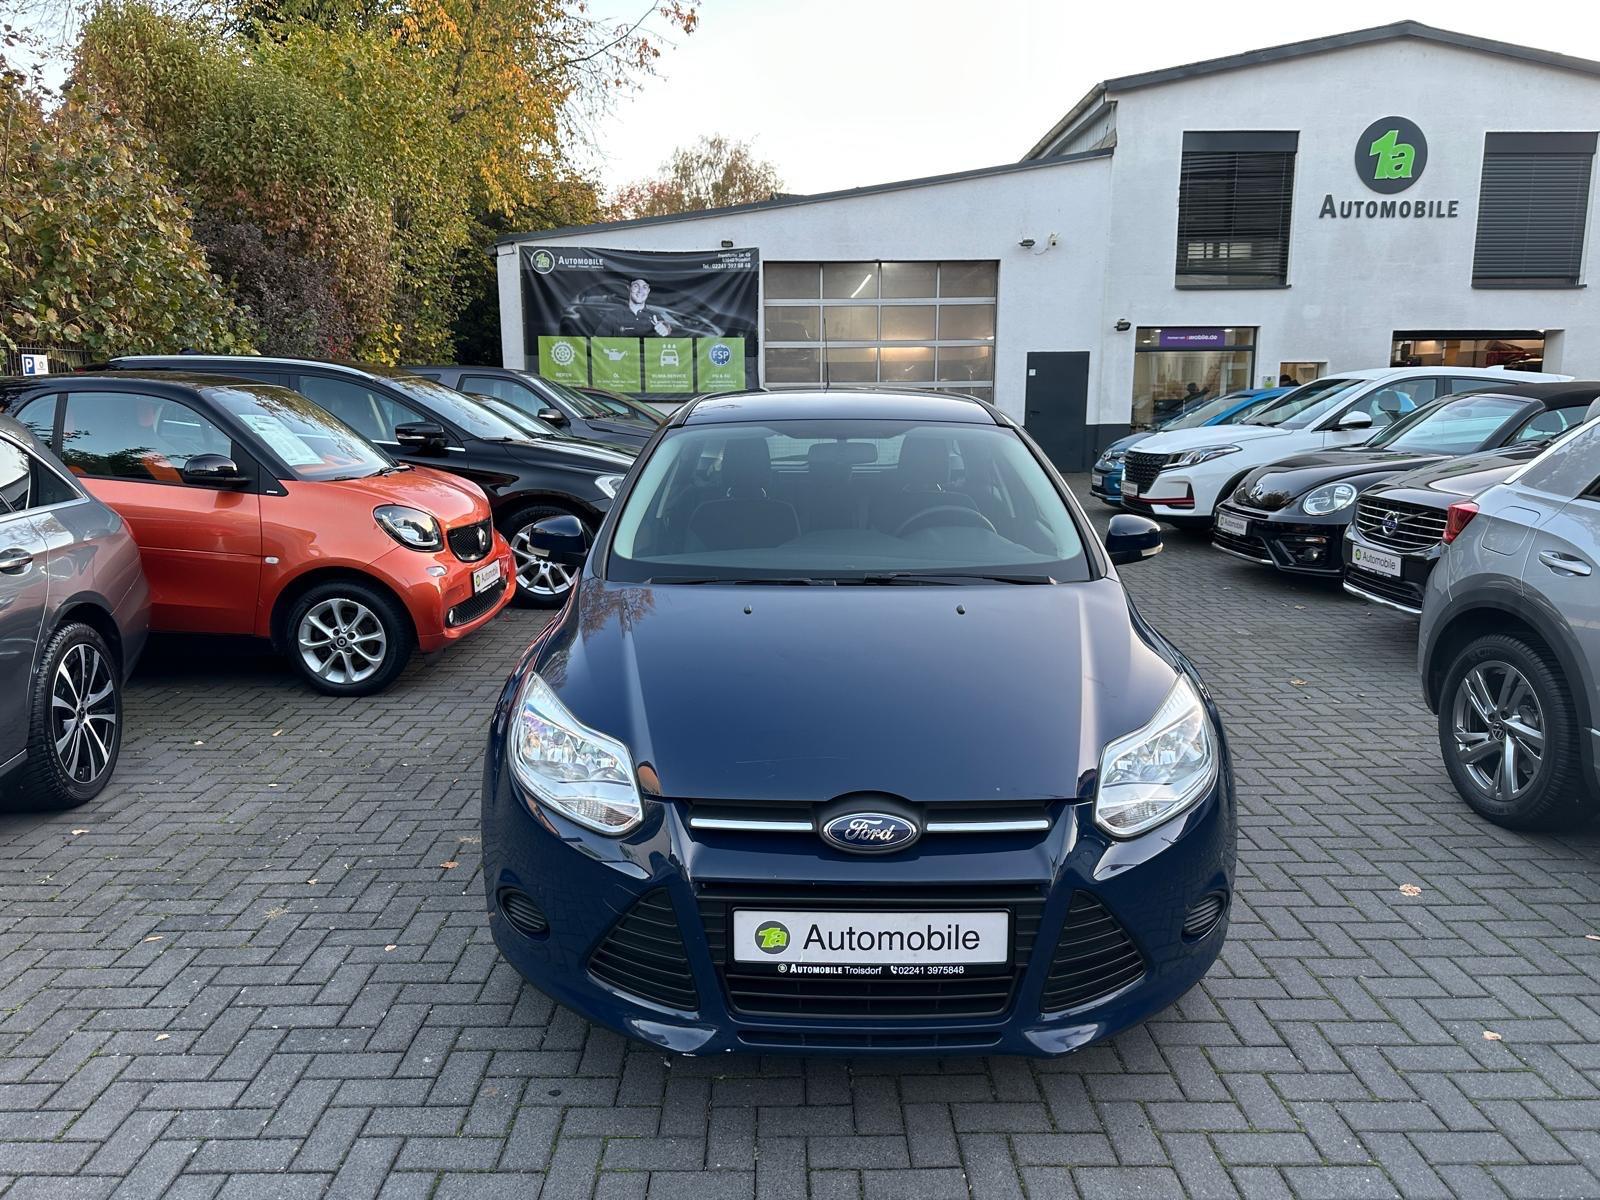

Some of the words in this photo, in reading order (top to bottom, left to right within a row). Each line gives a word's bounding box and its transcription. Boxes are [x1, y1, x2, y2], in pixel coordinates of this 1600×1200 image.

[1369, 130, 1416, 179] 1a
[1319, 194, 1459, 219] AUTOMOBILE
[558, 256, 604, 266] AUTOMOBILE
[712, 350, 729, 360] FSP
[25, 358, 33, 373] P
[1362, 551, 1396, 570] Automobile
[845, 818, 895, 842] Ford
[758, 927, 788, 949] 1a
[803, 924, 981, 951] Automobile
[790, 963, 843, 975] AUTOMOBILE
[844, 965, 882, 975] Troisdorf
[898, 965, 925, 975] 02241
[927, 965, 965, 975] 3975848
